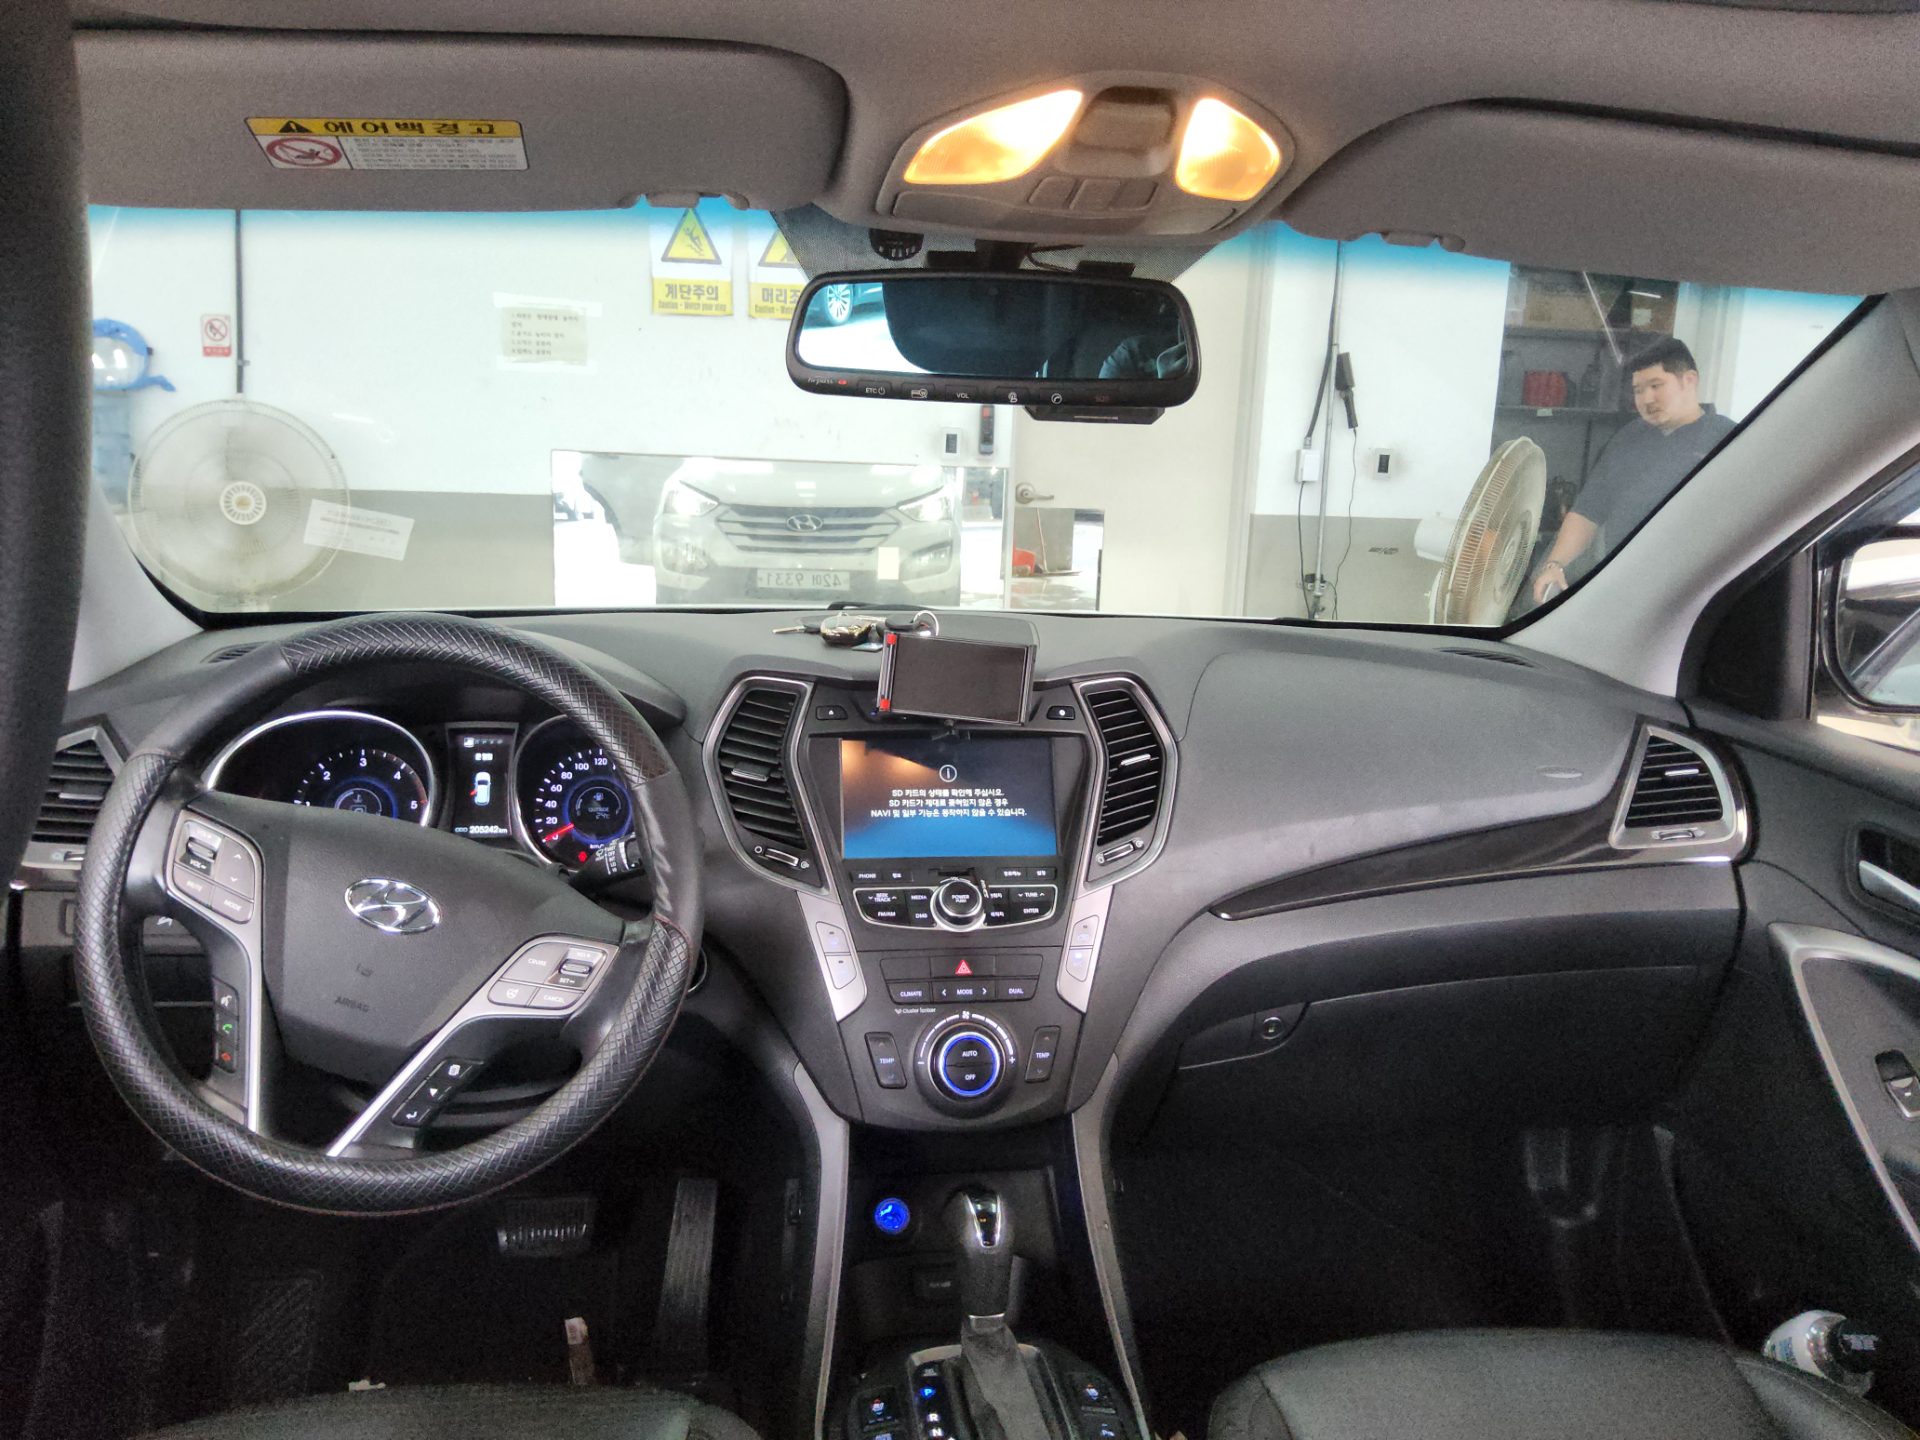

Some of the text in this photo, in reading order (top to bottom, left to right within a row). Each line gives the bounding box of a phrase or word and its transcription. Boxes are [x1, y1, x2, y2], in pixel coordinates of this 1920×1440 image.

[665, 283, 719, 301] 계단주의
[762, 288, 801, 305] 머리조
[359, 758, 367, 767] 3
[594, 757, 607, 766] 120
[574, 763, 589, 771] 100
[323, 771, 331, 780] 2
[393, 771, 401, 780] 4
[561, 772, 572, 780] 80
[551, 784, 562, 792] 60
[892, 789, 903, 797] SD
[905, 789, 926, 797] 카드의
[928, 789, 949, 797] 상태를
[951, 788, 972, 797] 확인해
[411, 801, 418, 809] 5
[545, 800, 557, 808] 40
[889, 799, 900, 807] SD
[902, 799, 923, 807] 카드가
[994, 798, 1008, 807] 경우
[870, 809, 891, 818] NAVI
[893, 809, 900, 818] 및
[902, 809, 916, 818] 일부
[918, 809, 940, 818] 기능은
[988, 808, 995, 817] 수
[997, 808, 1027, 817] 있습니다.
[962, 1050, 978, 1058] AUTO
[924, 1388, 933, 1396] P
[928, 1413, 939, 1422] R
[932, 1428, 943, 1437] N
